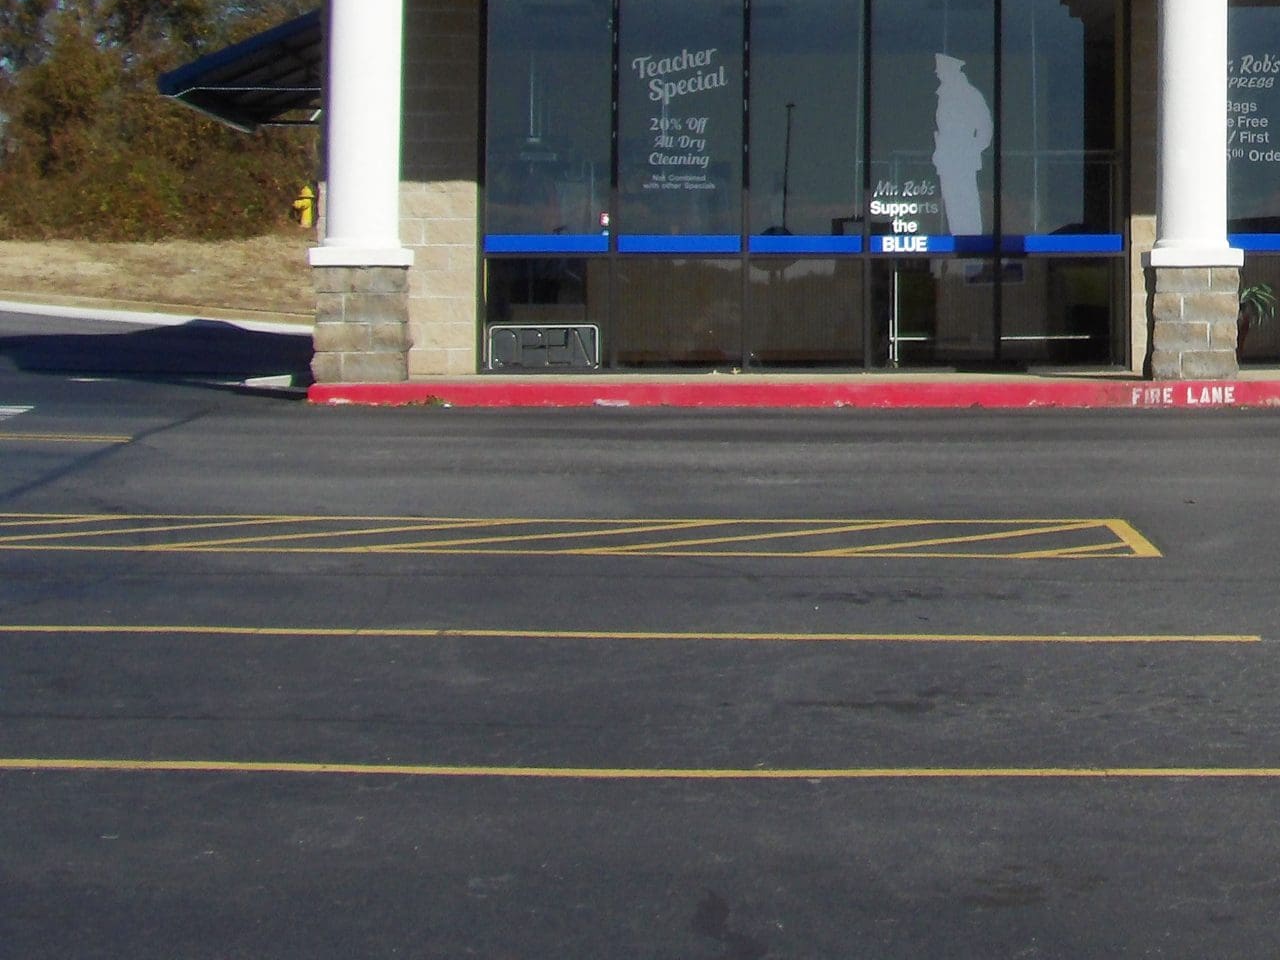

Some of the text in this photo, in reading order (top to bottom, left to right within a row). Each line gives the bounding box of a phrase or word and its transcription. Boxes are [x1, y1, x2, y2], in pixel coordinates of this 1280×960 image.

[632, 48, 717, 78] Teacher
[1240, 53, 1280, 74] Rob's
[649, 66, 729, 104] Special
[650, 117, 709, 134] 20% Off
[1237, 116, 1269, 128] Free
[654, 135, 706, 151] All Dry
[1239, 130, 1270, 143] First
[649, 151, 710, 168] Cleaning
[873, 180, 936, 197] Mr. Rob's
[870, 200, 938, 217] Supports
[892, 218, 918, 233] the
[882, 236, 928, 252] BLUE
[1131, 385, 1236, 405] FIRE LANE
